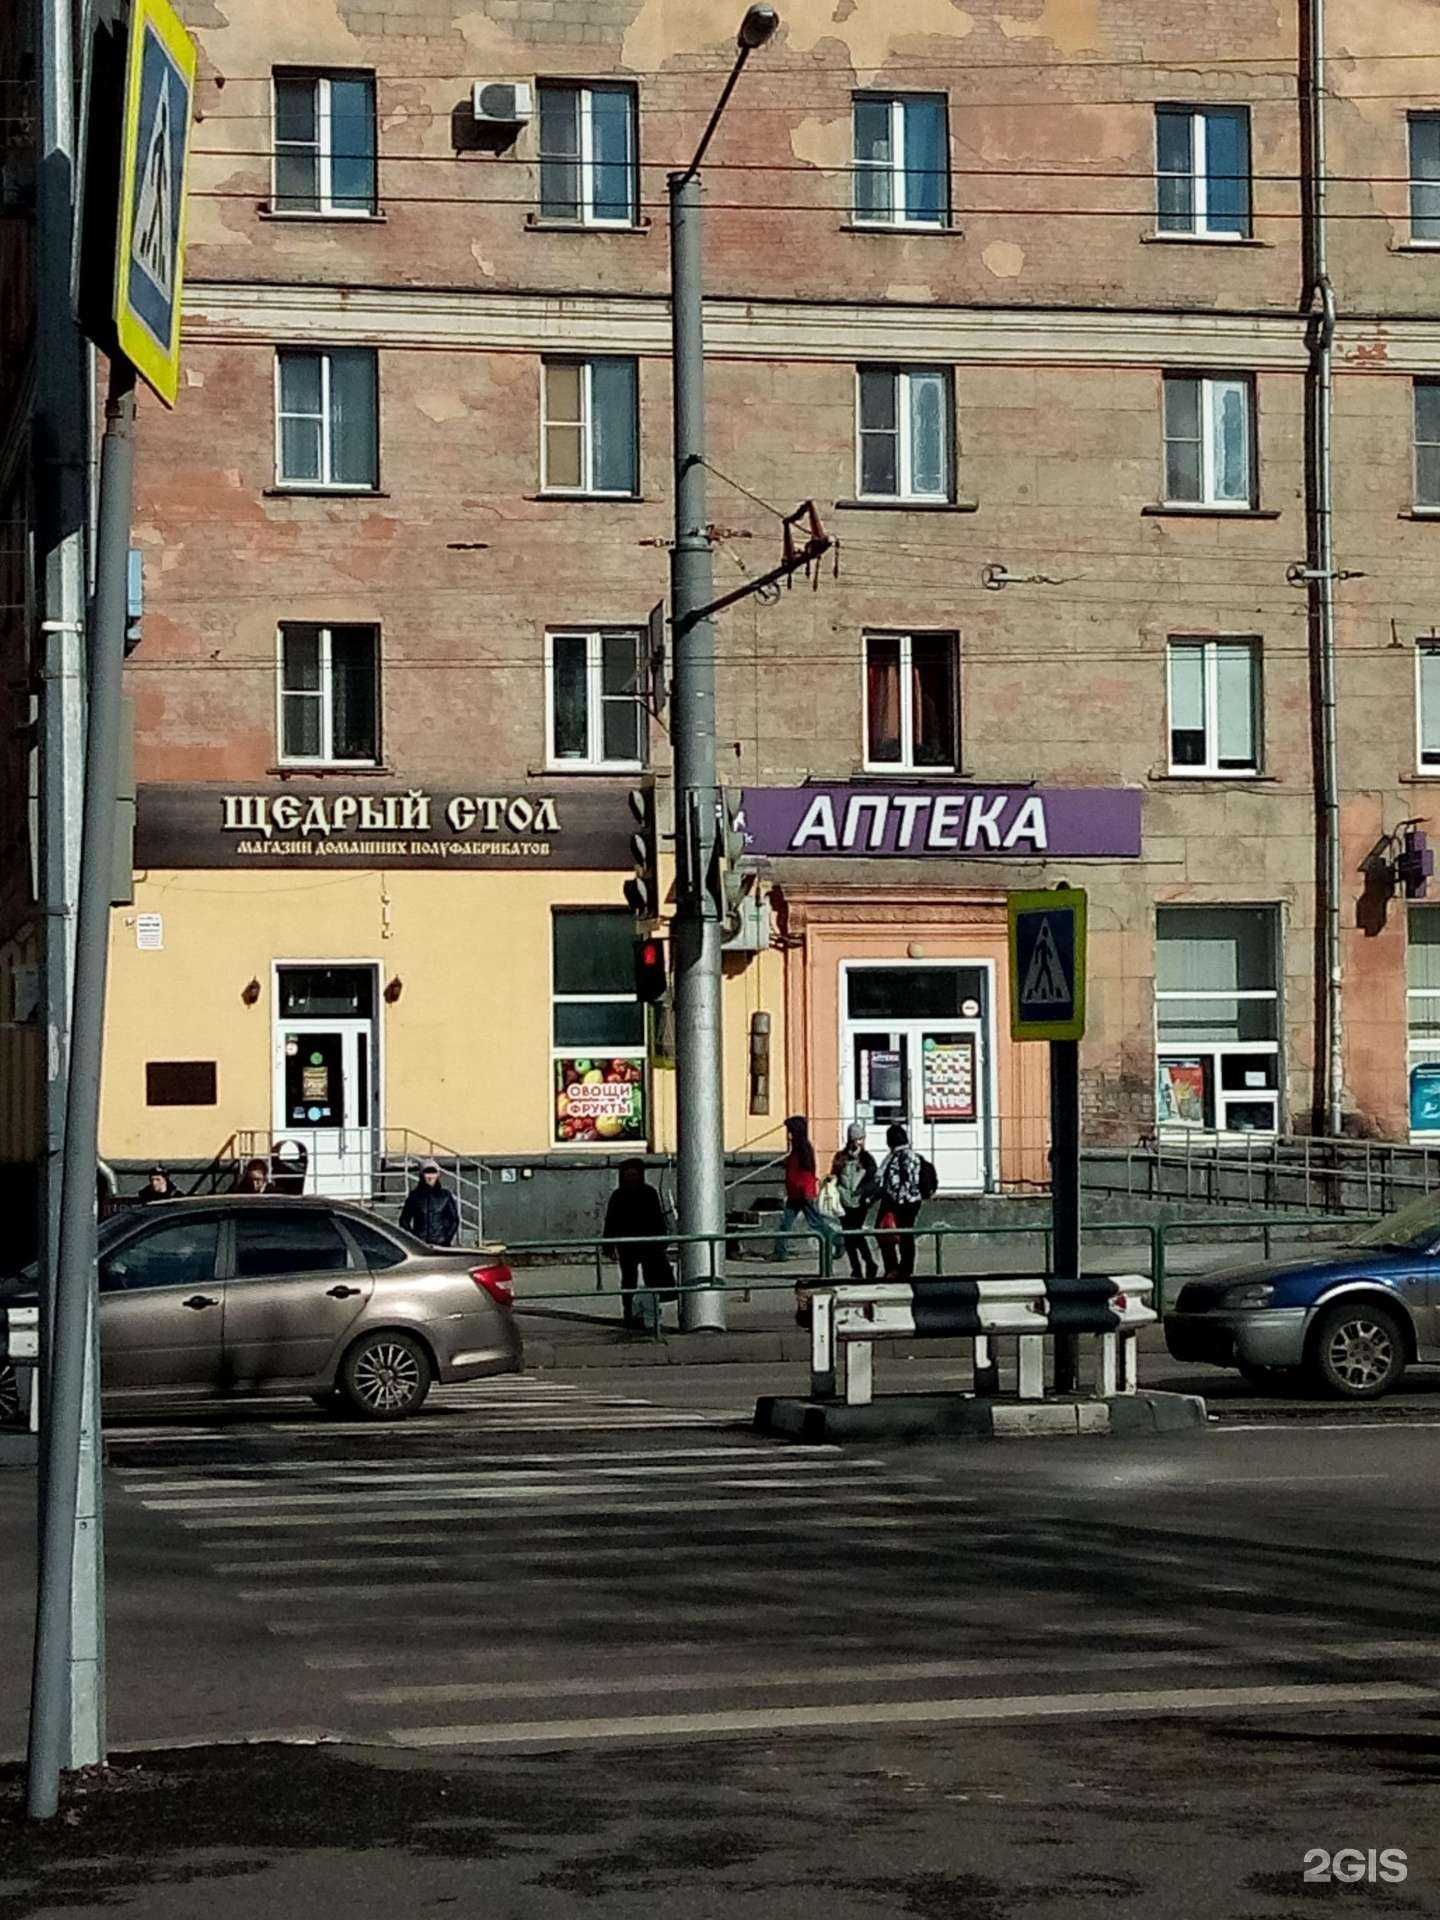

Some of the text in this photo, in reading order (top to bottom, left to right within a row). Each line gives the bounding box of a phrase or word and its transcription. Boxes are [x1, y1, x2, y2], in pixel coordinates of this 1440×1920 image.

[223, 789, 562, 838] ЩЕДРЫЙ СТОЛ
[791, 795, 1049, 848] АПТЕКА
[237, 841, 550, 858] МАГАЗИН ДОМАШНИХ ПОЛУФАБРИКАТОВ
[570, 1085, 630, 1099] ОВОЩИ
[569, 1103, 631, 1114] ФРУКТЫ
